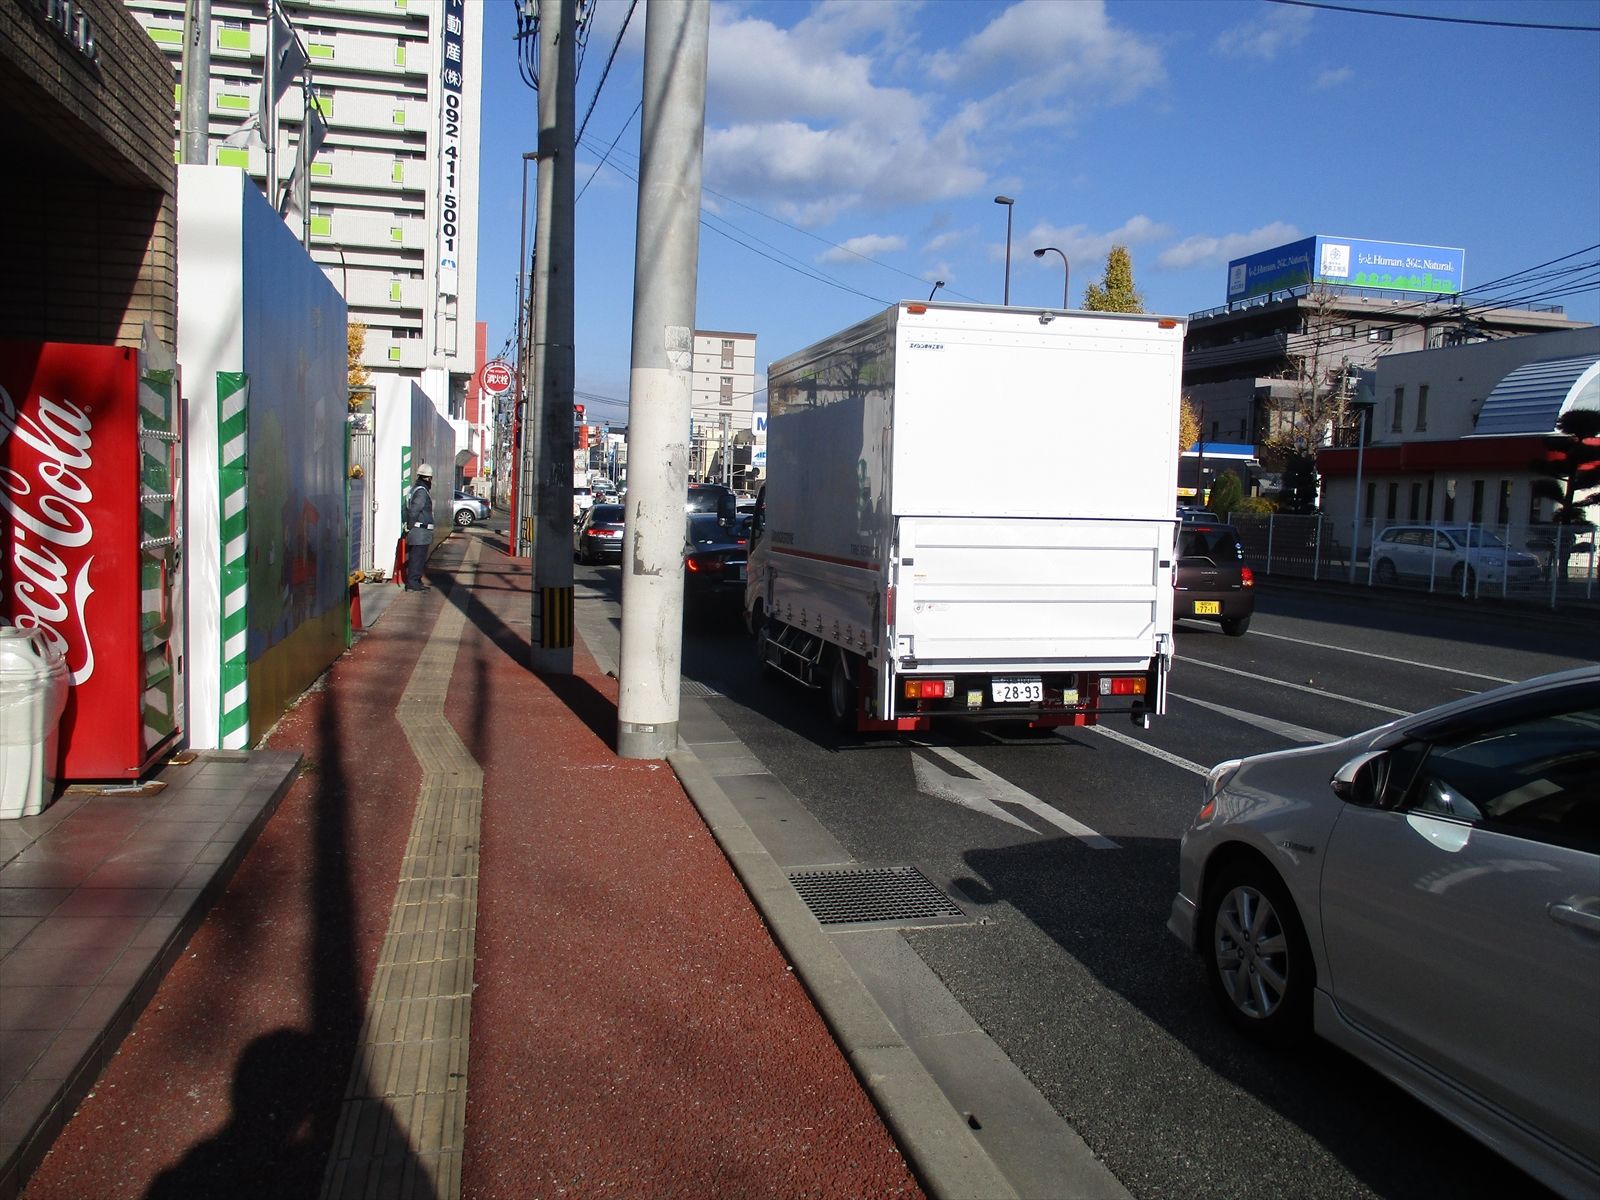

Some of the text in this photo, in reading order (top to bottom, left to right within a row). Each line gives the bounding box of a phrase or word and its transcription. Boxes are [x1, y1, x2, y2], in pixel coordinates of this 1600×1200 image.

[487, 374, 509, 385] 消火栓
[0, 395, 94, 684] oca-Cola
[1004, 686, 1040, 699] 28-93
